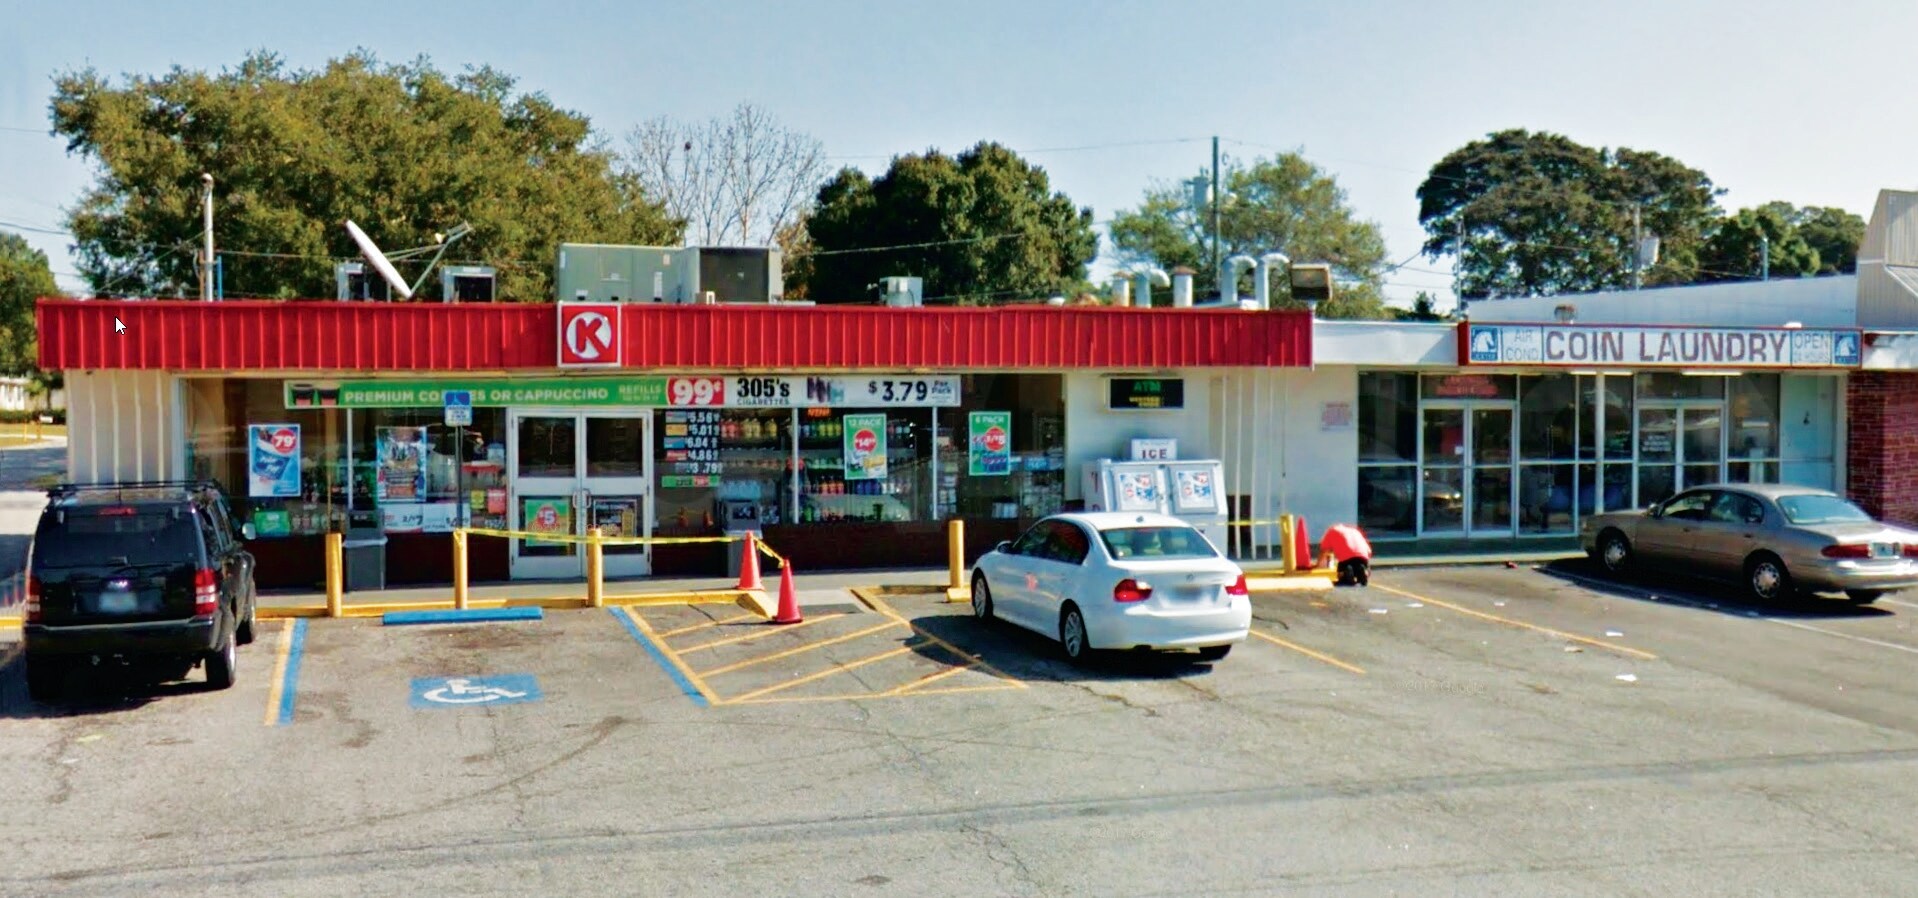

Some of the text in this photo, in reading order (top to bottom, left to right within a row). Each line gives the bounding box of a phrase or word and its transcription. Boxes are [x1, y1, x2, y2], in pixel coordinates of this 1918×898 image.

[576, 318, 606, 353] K
[1514, 330, 1533, 342] AIR
[1795, 332, 1829, 349] OPEN
[1546, 332, 1787, 362] COIN LAUNDRY
[618, 384, 662, 394] REFILLS
[737, 378, 790, 397] 305's
[931, 385, 952, 394] Pack
[1134, 381, 1160, 392] ATM
[345, 391, 414, 403] PREMIUM
[418, 390, 486, 402] COES
[490, 389, 511, 400] OR
[515, 388, 608, 400] CAPPUCCINO
[737, 398, 790, 406] CIGARETTES
[982, 416, 1005, 424] PACK
[1142, 449, 1168, 459] ICE
